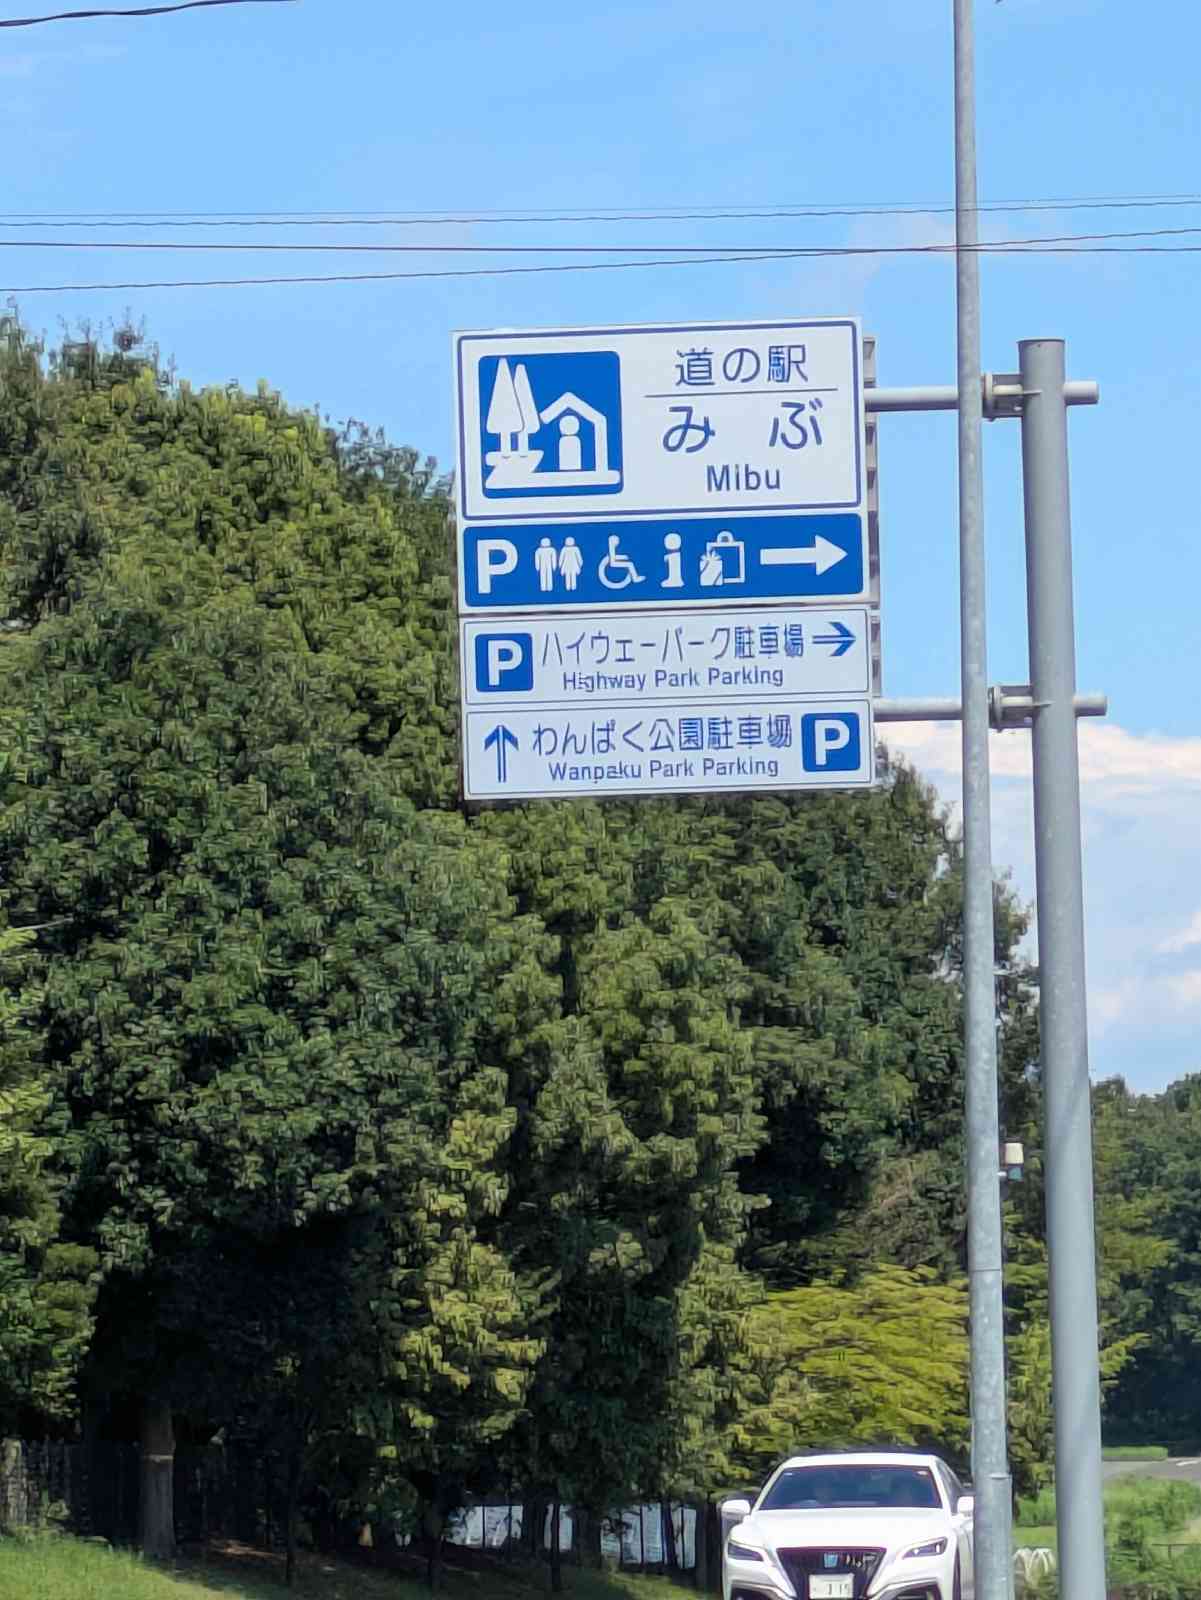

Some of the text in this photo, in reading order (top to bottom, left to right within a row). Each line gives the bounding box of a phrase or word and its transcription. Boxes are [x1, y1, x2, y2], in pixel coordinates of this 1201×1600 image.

[675, 344, 808, 386] 道の駅
[706, 464, 781, 492] Mibu
[476, 538, 519, 593] P
[487, 639, 524, 686] P
[542, 622, 804, 666] ハイウェーパーク駐車場
[563, 667, 784, 693] Highway Park Parking
[532, 714, 792, 756] わんぱく公園駐車場
[815, 720, 850, 765] P
[549, 757, 779, 784] Wanpaku Park Parking
